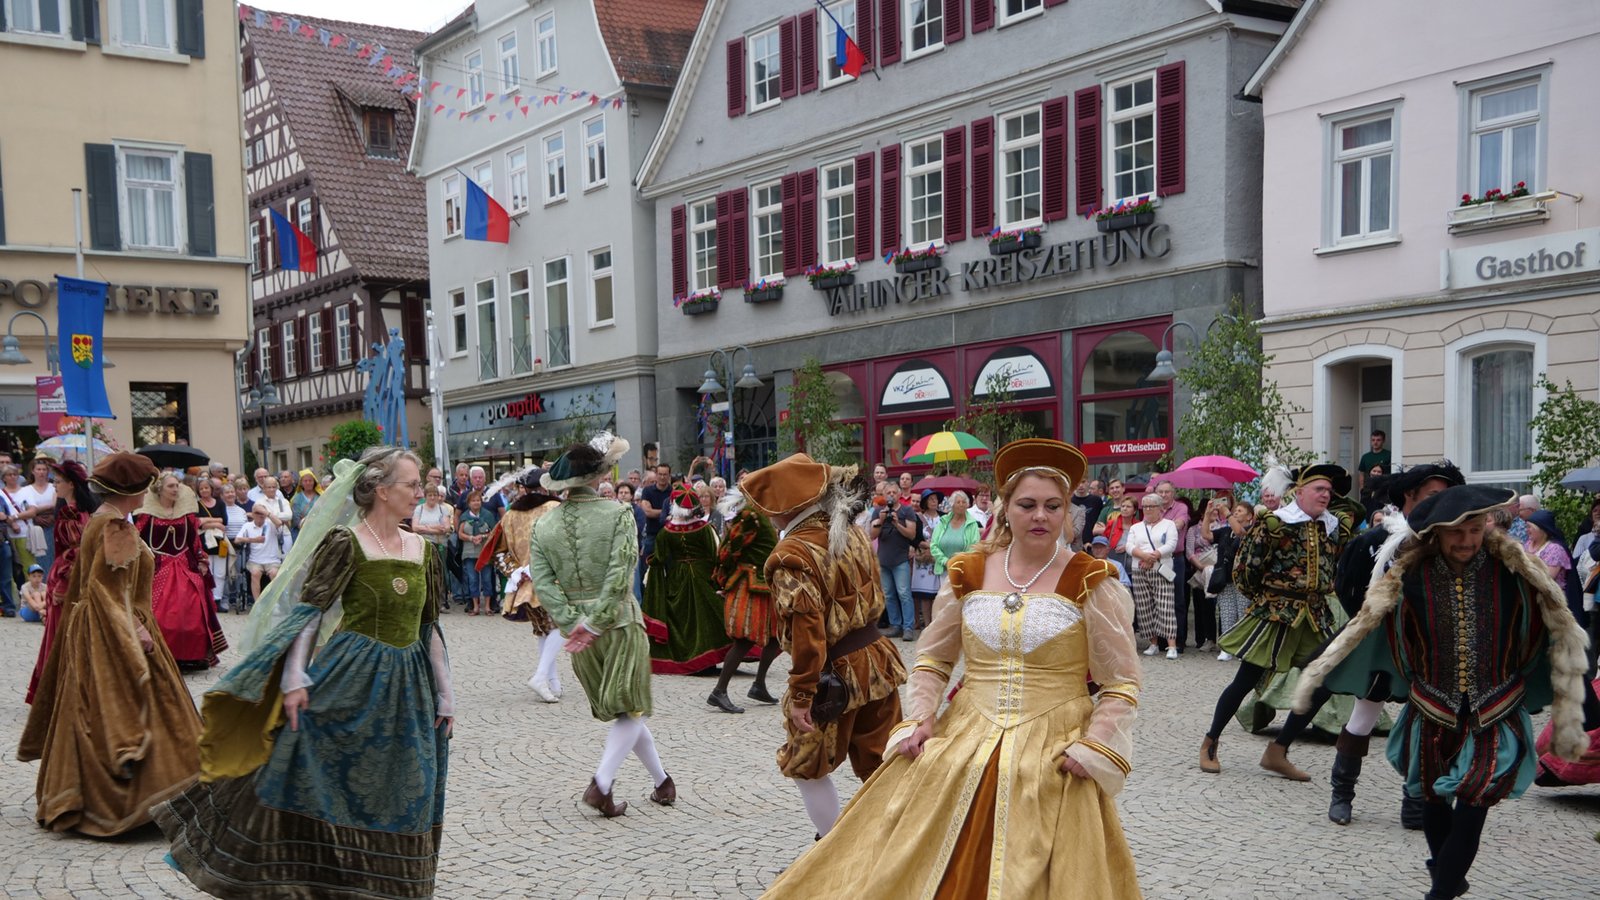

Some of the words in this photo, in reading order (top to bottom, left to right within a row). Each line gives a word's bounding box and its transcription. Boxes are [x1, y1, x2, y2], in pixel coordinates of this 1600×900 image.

[822, 267, 950, 316] VAIHINGER
[961, 224, 1170, 291] KREISZEITUNG
[1476, 242, 1586, 281] Gasthof
[1110, 443, 1127, 454] VKZ
[1127, 441, 1166, 453] Reisebüro
